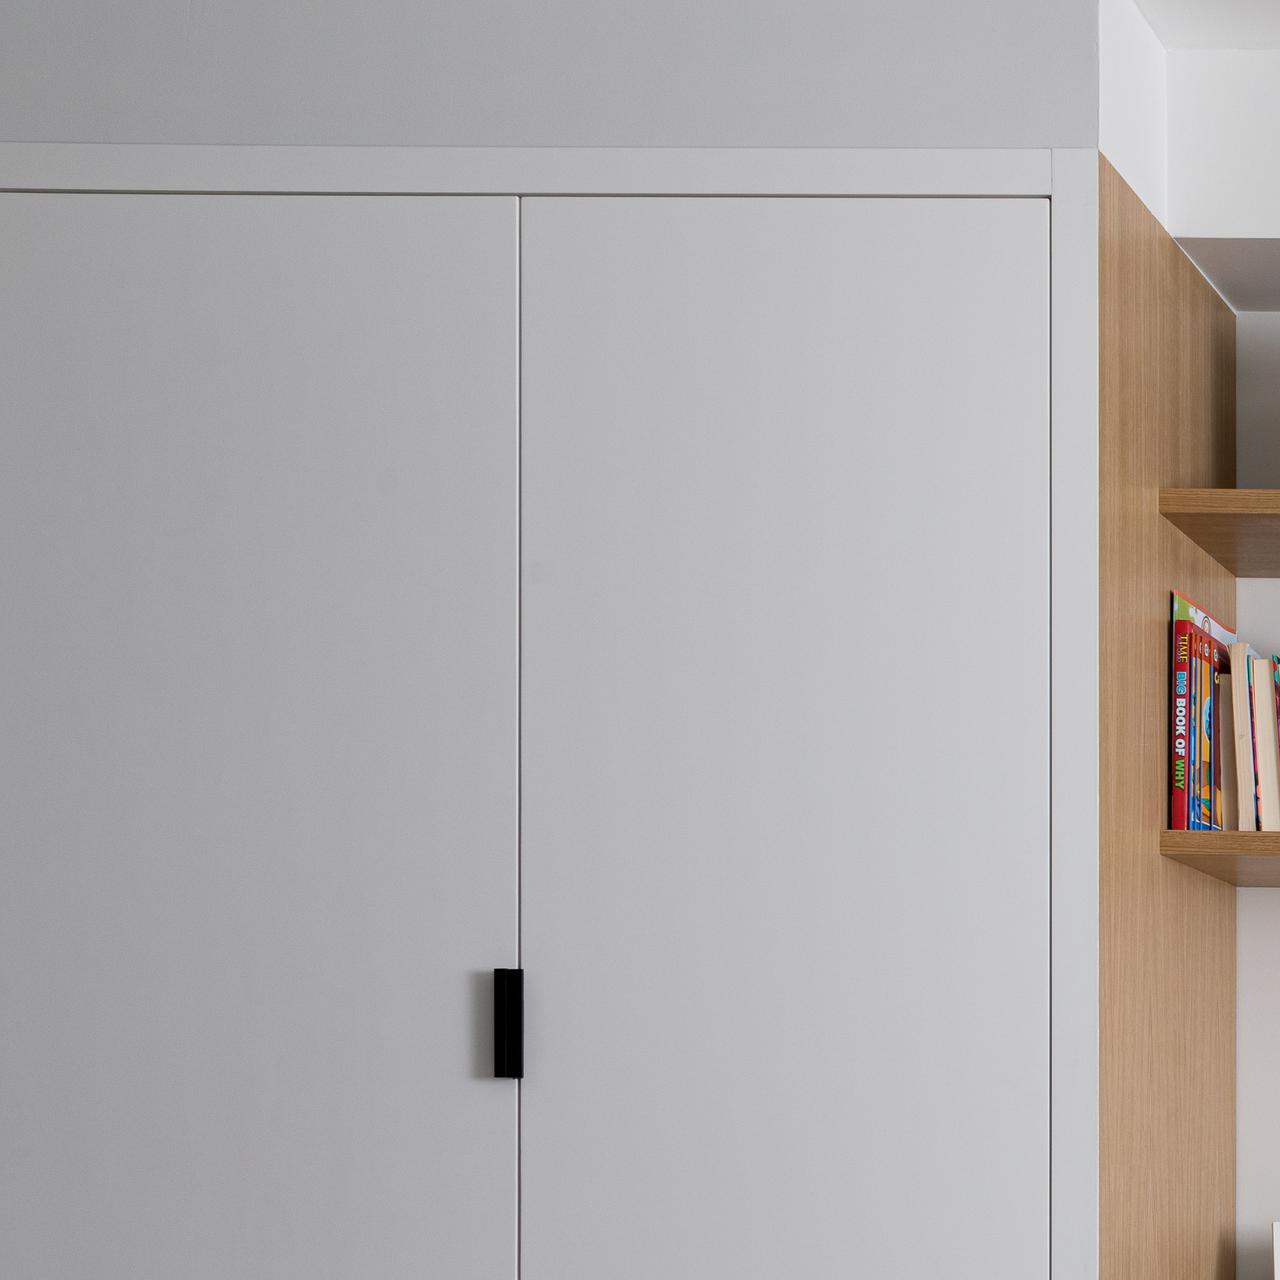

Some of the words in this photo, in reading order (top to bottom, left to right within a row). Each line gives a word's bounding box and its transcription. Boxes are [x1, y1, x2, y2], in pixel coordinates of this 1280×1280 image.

[1179, 634, 1188, 662] TIME
[1176, 672, 1187, 694] BIG
[1175, 698, 1187, 736] BOOK
[1175, 738, 1186, 757] OF
[1175, 760, 1185, 790] WHY
